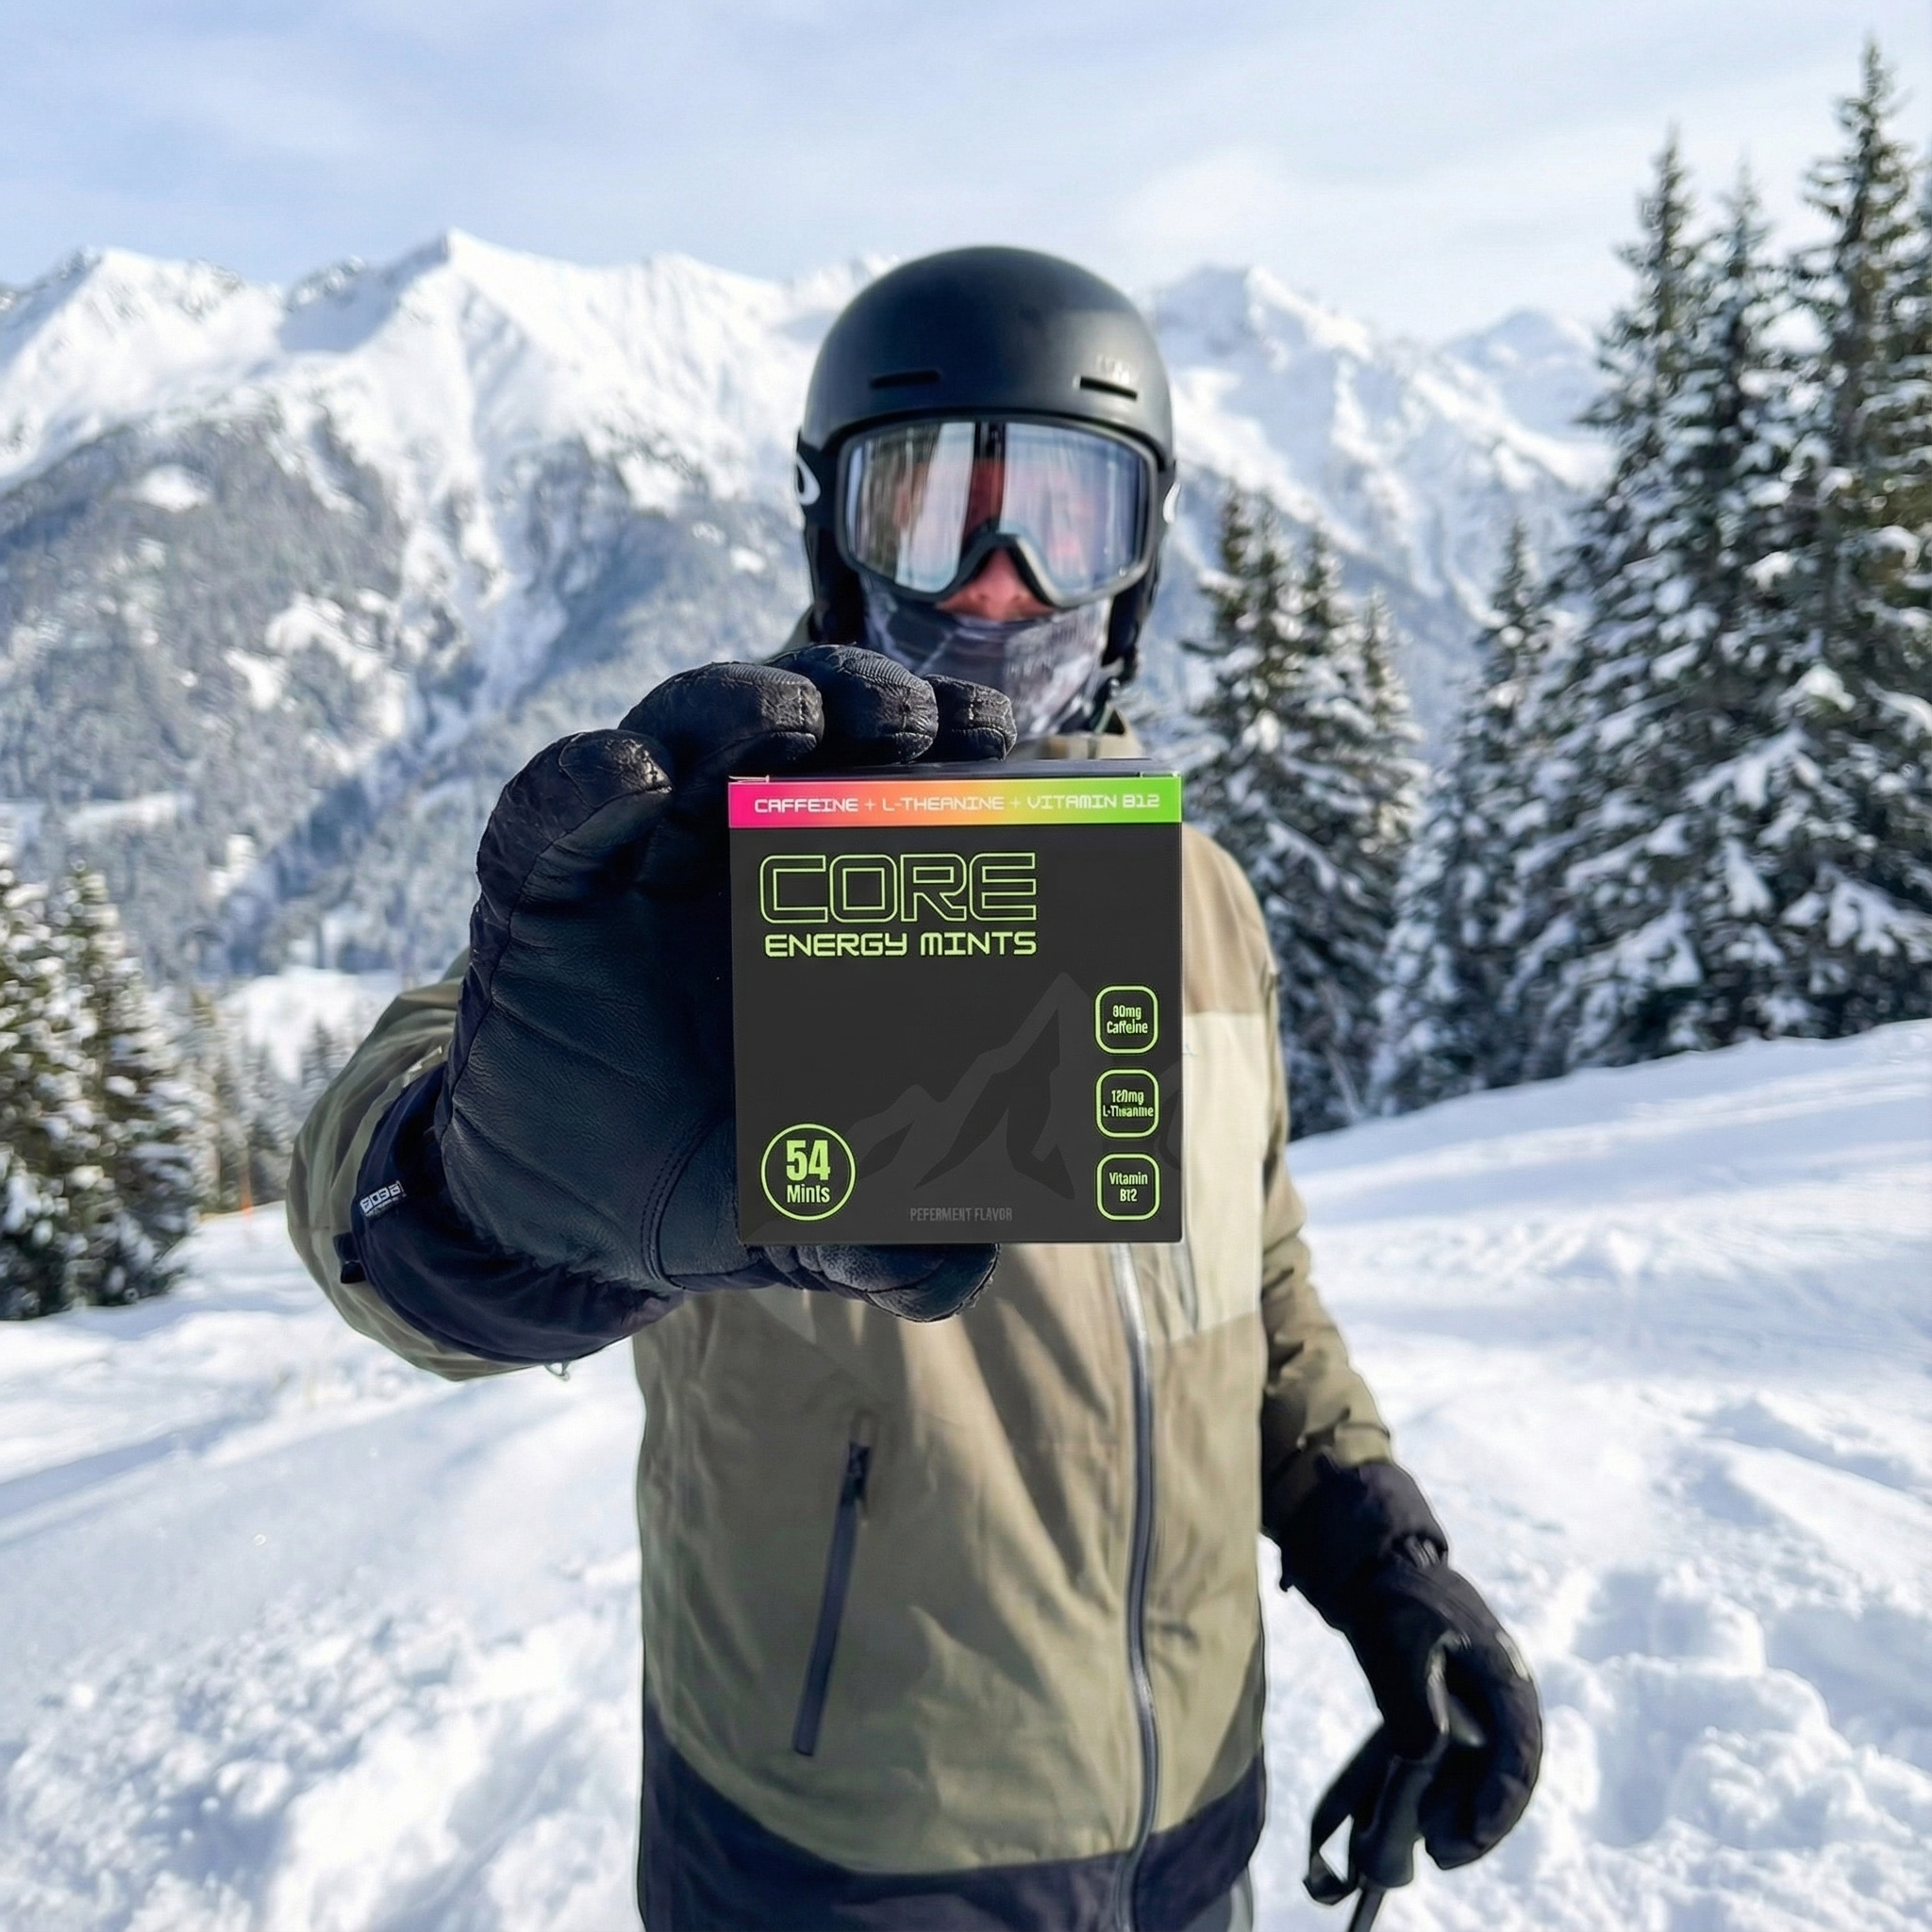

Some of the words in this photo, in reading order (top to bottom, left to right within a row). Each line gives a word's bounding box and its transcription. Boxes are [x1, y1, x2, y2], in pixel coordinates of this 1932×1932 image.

[754, 797, 858, 814] CAFFEINE
[864, 798, 874, 811] +
[882, 796, 1005, 812] L-THEANINE
[1009, 796, 1022, 809] +
[1026, 794, 1117, 810] VITAMIN
[1122, 793, 1160, 809] B12
[759, 852, 1039, 924] CORE
[764, 932, 908, 958] ENERGY
[920, 931, 1037, 956] MINTS
[785, 1139, 831, 1181] 54
[1108, 1172, 1148, 1186] Vitamin
[786, 1183, 831, 1204] Mints
[1120, 1188, 1138, 1203] B12
[974, 1207, 1013, 1222] FLAVOR
